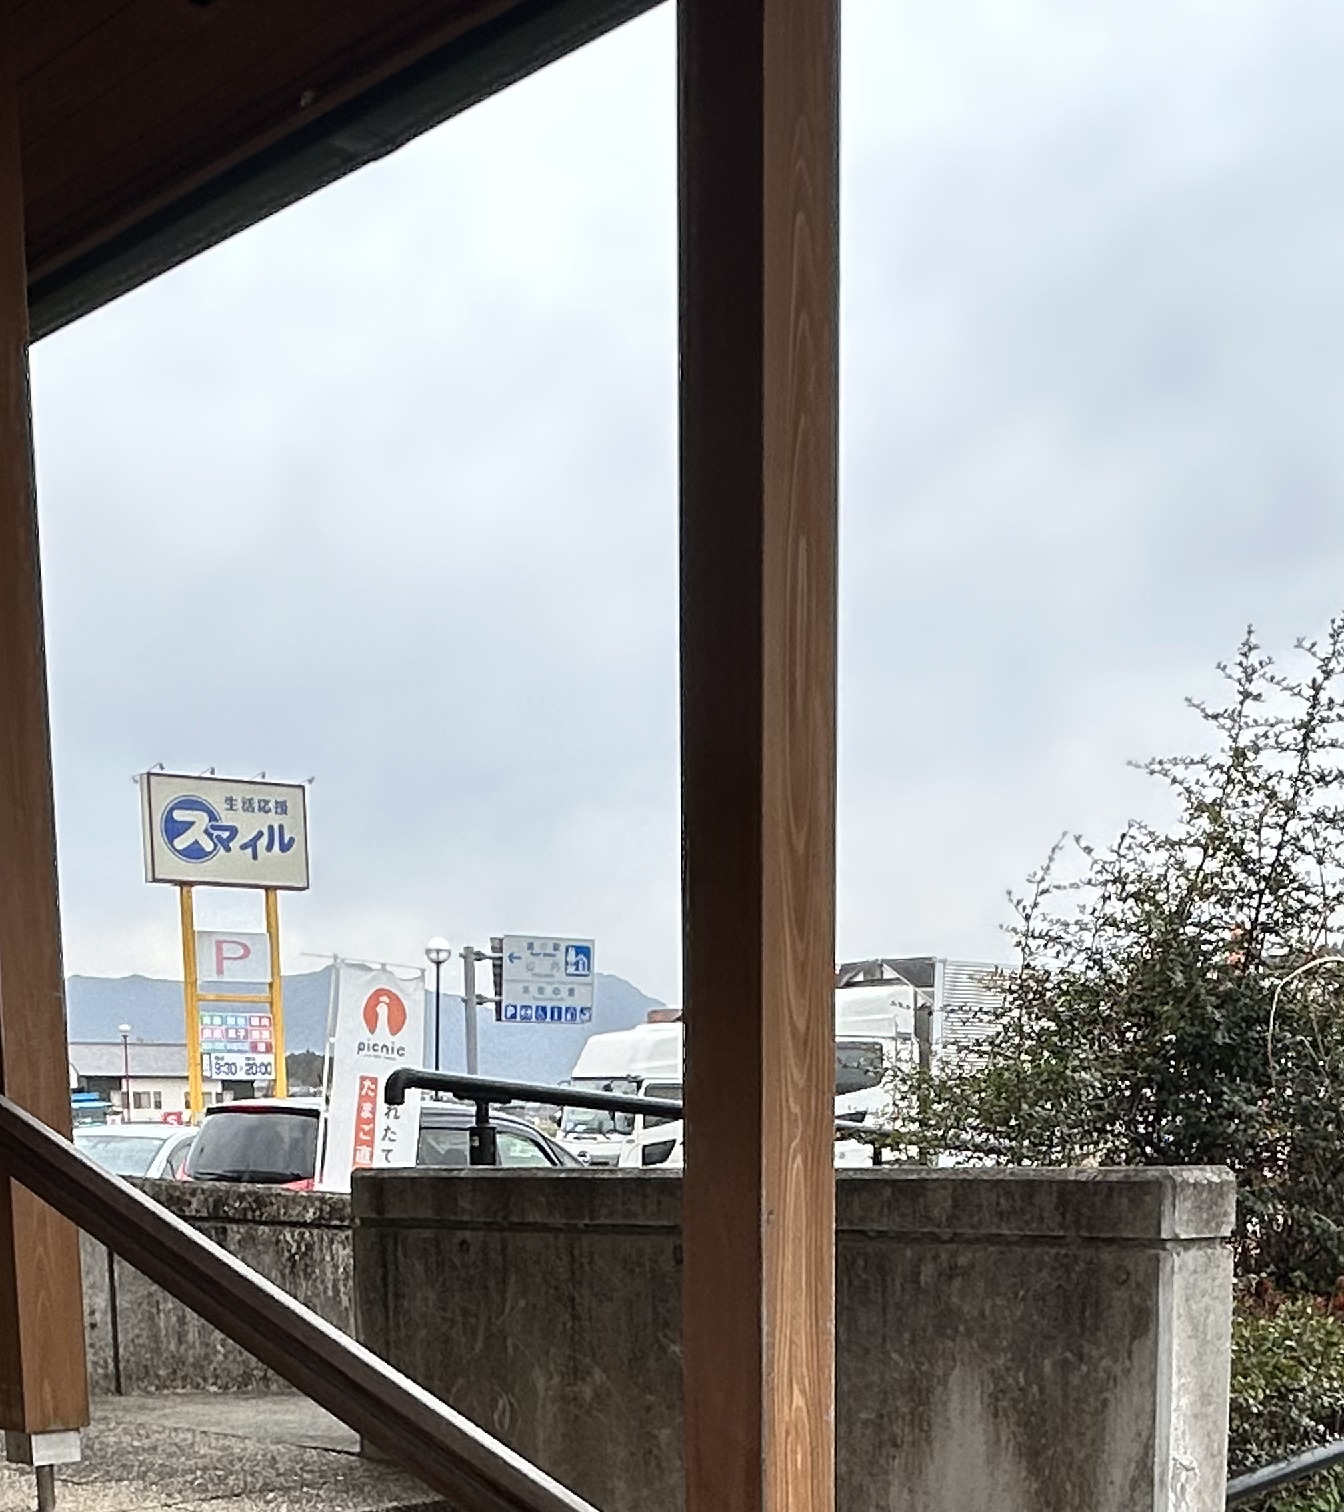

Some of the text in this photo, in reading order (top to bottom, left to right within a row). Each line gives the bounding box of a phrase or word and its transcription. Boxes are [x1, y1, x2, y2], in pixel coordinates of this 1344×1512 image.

[224, 796, 288, 815] 生活応援
[172, 809, 295, 861] スマイル
[215, 939, 252, 977] P
[356, 1038, 406, 1058] picnic
[381, 1104, 401, 1164] れたて
